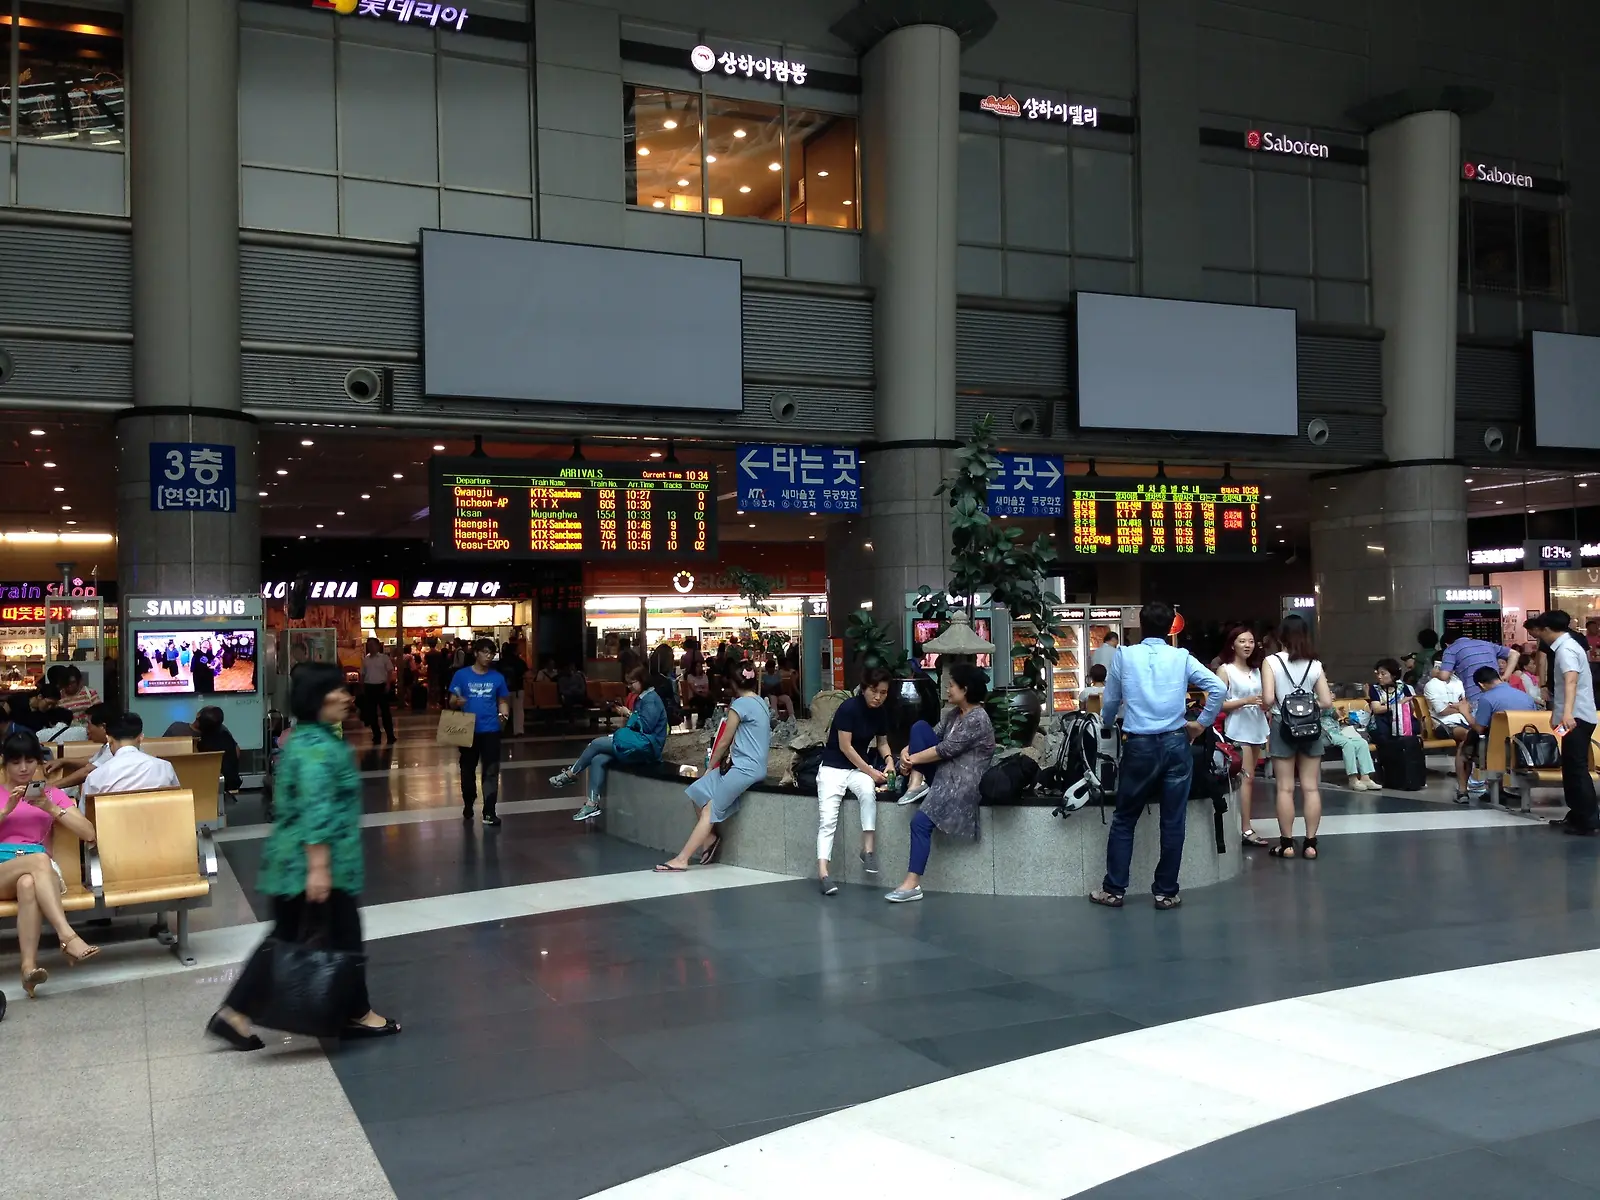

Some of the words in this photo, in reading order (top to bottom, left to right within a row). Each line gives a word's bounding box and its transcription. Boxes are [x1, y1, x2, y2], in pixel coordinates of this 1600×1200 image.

[718, 51, 807, 84] 상하이짬뽕
[1263, 132, 1329, 159] Saboten
[1477, 163, 1533, 188] Saboten
[164, 448, 223, 485] 3층
[773, 447, 824, 484] 타는
[832, 449, 856, 485] 곳
[560, 468, 603, 478] ARRIVALS
[642, 470, 666, 478] Current
[1013, 457, 1033, 490] 곳
[456, 477, 491, 485] Departure
[549, 479, 566, 487] Name
[608, 480, 618, 488] No.
[662, 481, 683, 489] Tracks
[690, 482, 709, 490] Delay
[454, 487, 493, 498] Gwangju
[530, 488, 581, 498] KTX-Sancheon
[599, 489, 616, 499] 604
[626, 490, 651, 500] 10:27
[698, 491, 705, 500] 0
[748, 488, 768, 499] KTX
[781, 489, 816, 500] 새마을호
[823, 490, 857, 500] 무궁화호
[1242, 486, 1259, 494] 10:34
[456, 497, 509, 507] Incheon-AP
[599, 499, 616, 509] 605
[626, 500, 651, 510] 10:30
[698, 501, 705, 510] 0
[995, 496, 1025, 506] 새마을호
[1151, 501, 1163, 510] 604
[1174, 502, 1192, 510] 10:35
[1250, 503, 1256, 511] 0
[456, 508, 482, 517] Iksan
[531, 509, 577, 519] Mugunghwa
[596, 510, 616, 519] 1554
[627, 510, 651, 520] 10:33
[667, 511, 676, 520] 13
[694, 511, 705, 520] 02
[1151, 510, 1164, 518] 605
[1174, 511, 1192, 519] 10:37
[454, 518, 498, 529] Haengsin
[531, 519, 582, 529] KTX-Sancheon
[600, 520, 616, 529] 509
[626, 520, 651, 530] 10:46
[670, 521, 677, 530] 9
[698, 521, 705, 530] 0
[1149, 519, 1163, 527] 1141
[454, 528, 498, 539] Haengsin
[531, 529, 582, 539] KTX-Sancheon
[601, 530, 616, 539] 705
[627, 530, 652, 540] 10:46
[670, 531, 677, 540] 9
[698, 531, 705, 540] 0
[1175, 528, 1193, 536] 10:55
[455, 540, 510, 550] Yeosu-EXPO
[531, 540, 582, 550] KTX-Sancheon
[601, 540, 616, 550] 714
[627, 541, 651, 550] 10:51
[667, 541, 677, 550] 10
[694, 541, 705, 551] 02
[1251, 537, 1257, 545] 0
[1252, 545, 1257, 553] 0
[1542, 546, 1566, 559] 10:34
[0, 582, 41, 599] rain
[262, 581, 358, 599] LOERIA
[1445, 589, 1492, 601] SAMSUNG
[147, 599, 245, 616] SAMSUNG
[2, 606, 46, 621] 따뜻한
